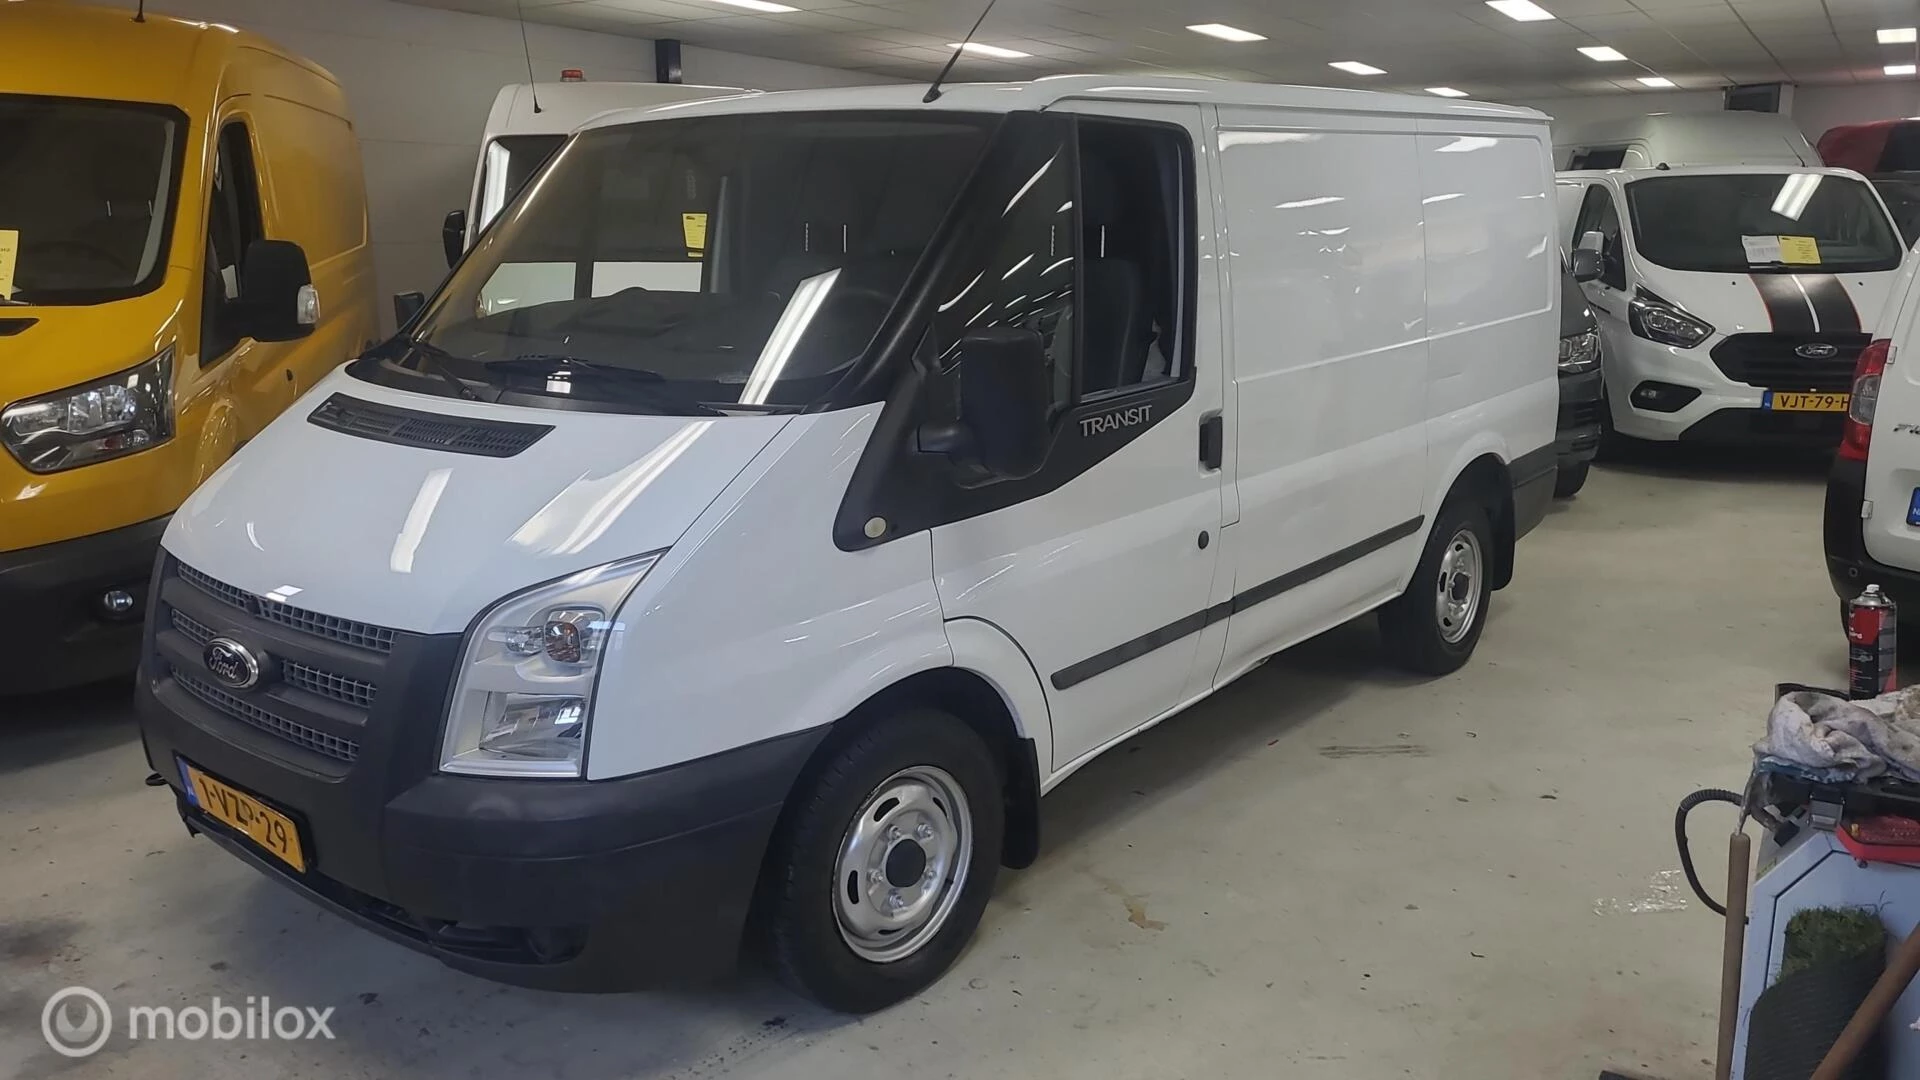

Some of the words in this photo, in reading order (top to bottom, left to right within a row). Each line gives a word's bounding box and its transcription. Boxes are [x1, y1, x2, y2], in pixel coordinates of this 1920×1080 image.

[1780, 395, 1849, 409] VJT-79-H
[1080, 404, 1153, 437] TRANSIT
[209, 646, 239, 679] Ford
[198, 777, 287, 854] 1-VZP-29
